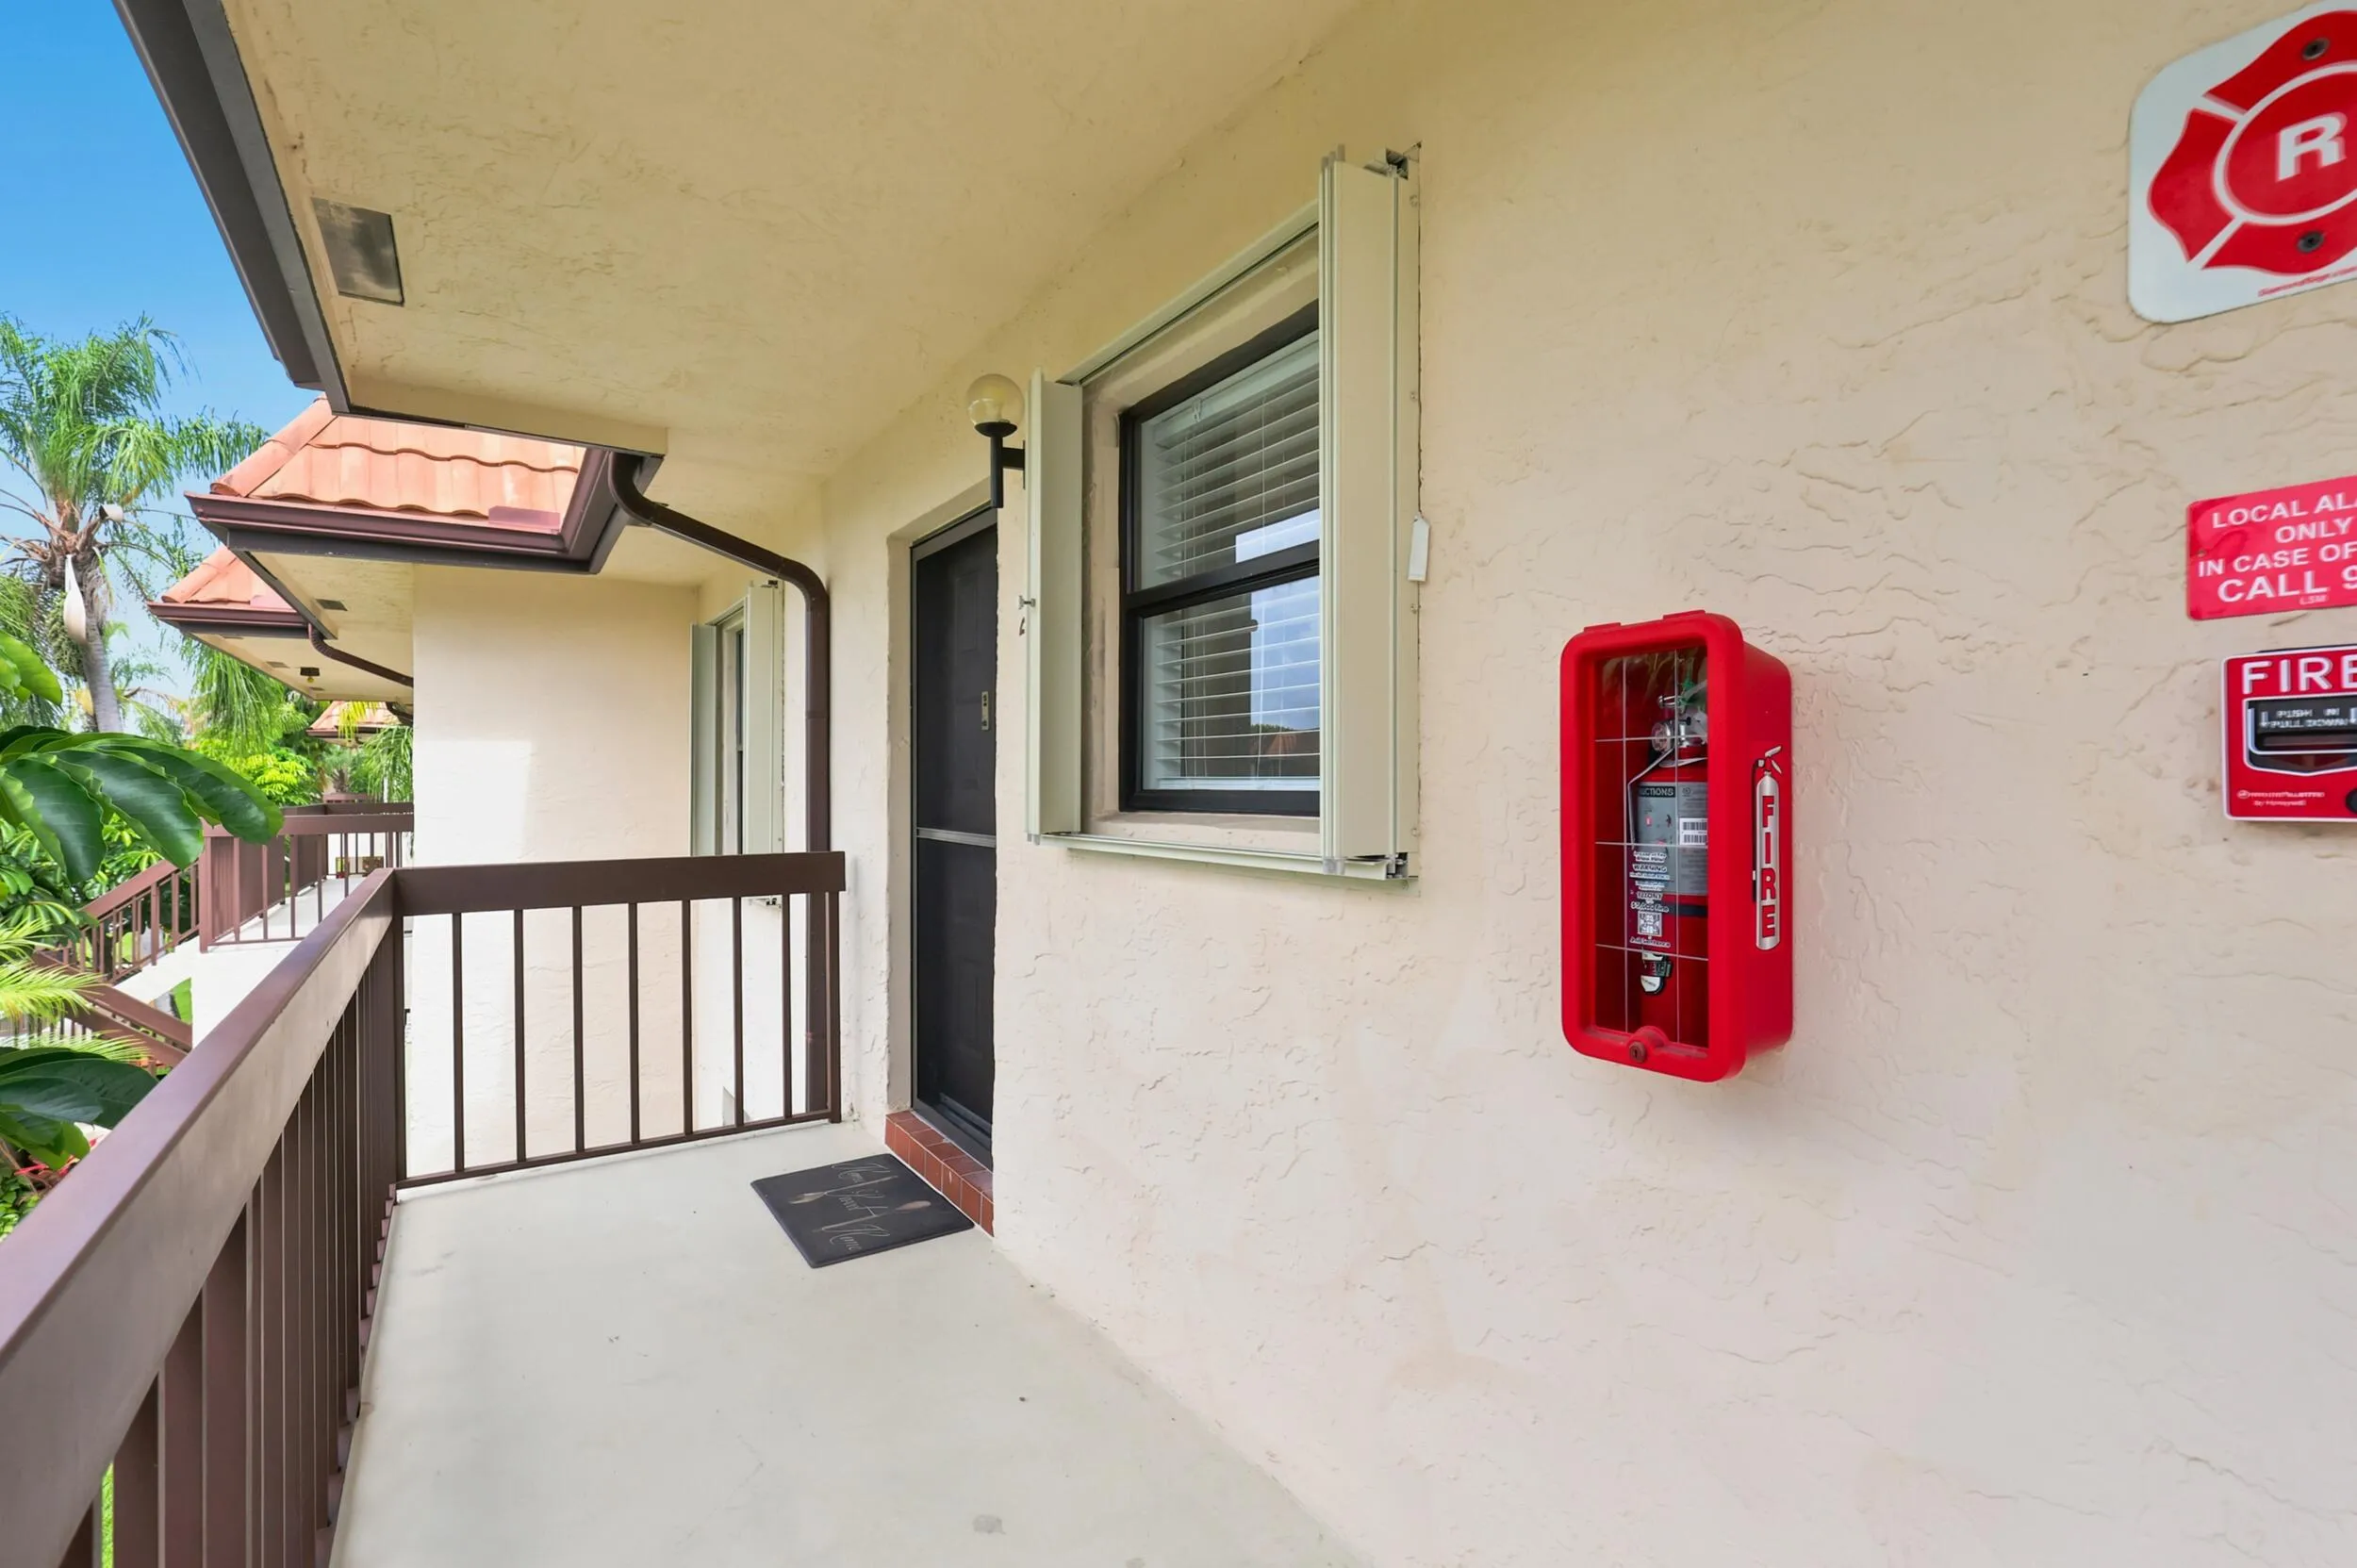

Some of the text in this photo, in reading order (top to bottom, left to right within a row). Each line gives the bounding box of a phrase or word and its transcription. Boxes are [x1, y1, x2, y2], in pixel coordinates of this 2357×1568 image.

[2275, 110, 2348, 182] R
[2212, 491, 2357, 528] LOCAL AL
[2274, 516, 2354, 544] ONLY
[2198, 540, 2357, 577] IN CASE OF
[2217, 569, 2331, 602] CALL
[2242, 654, 2357, 695] FIRE
[2268, 718, 2349, 729] PULL DOWN
[2276, 708, 2314, 718] PUSH
[1760, 795, 1776, 938] FIRE
